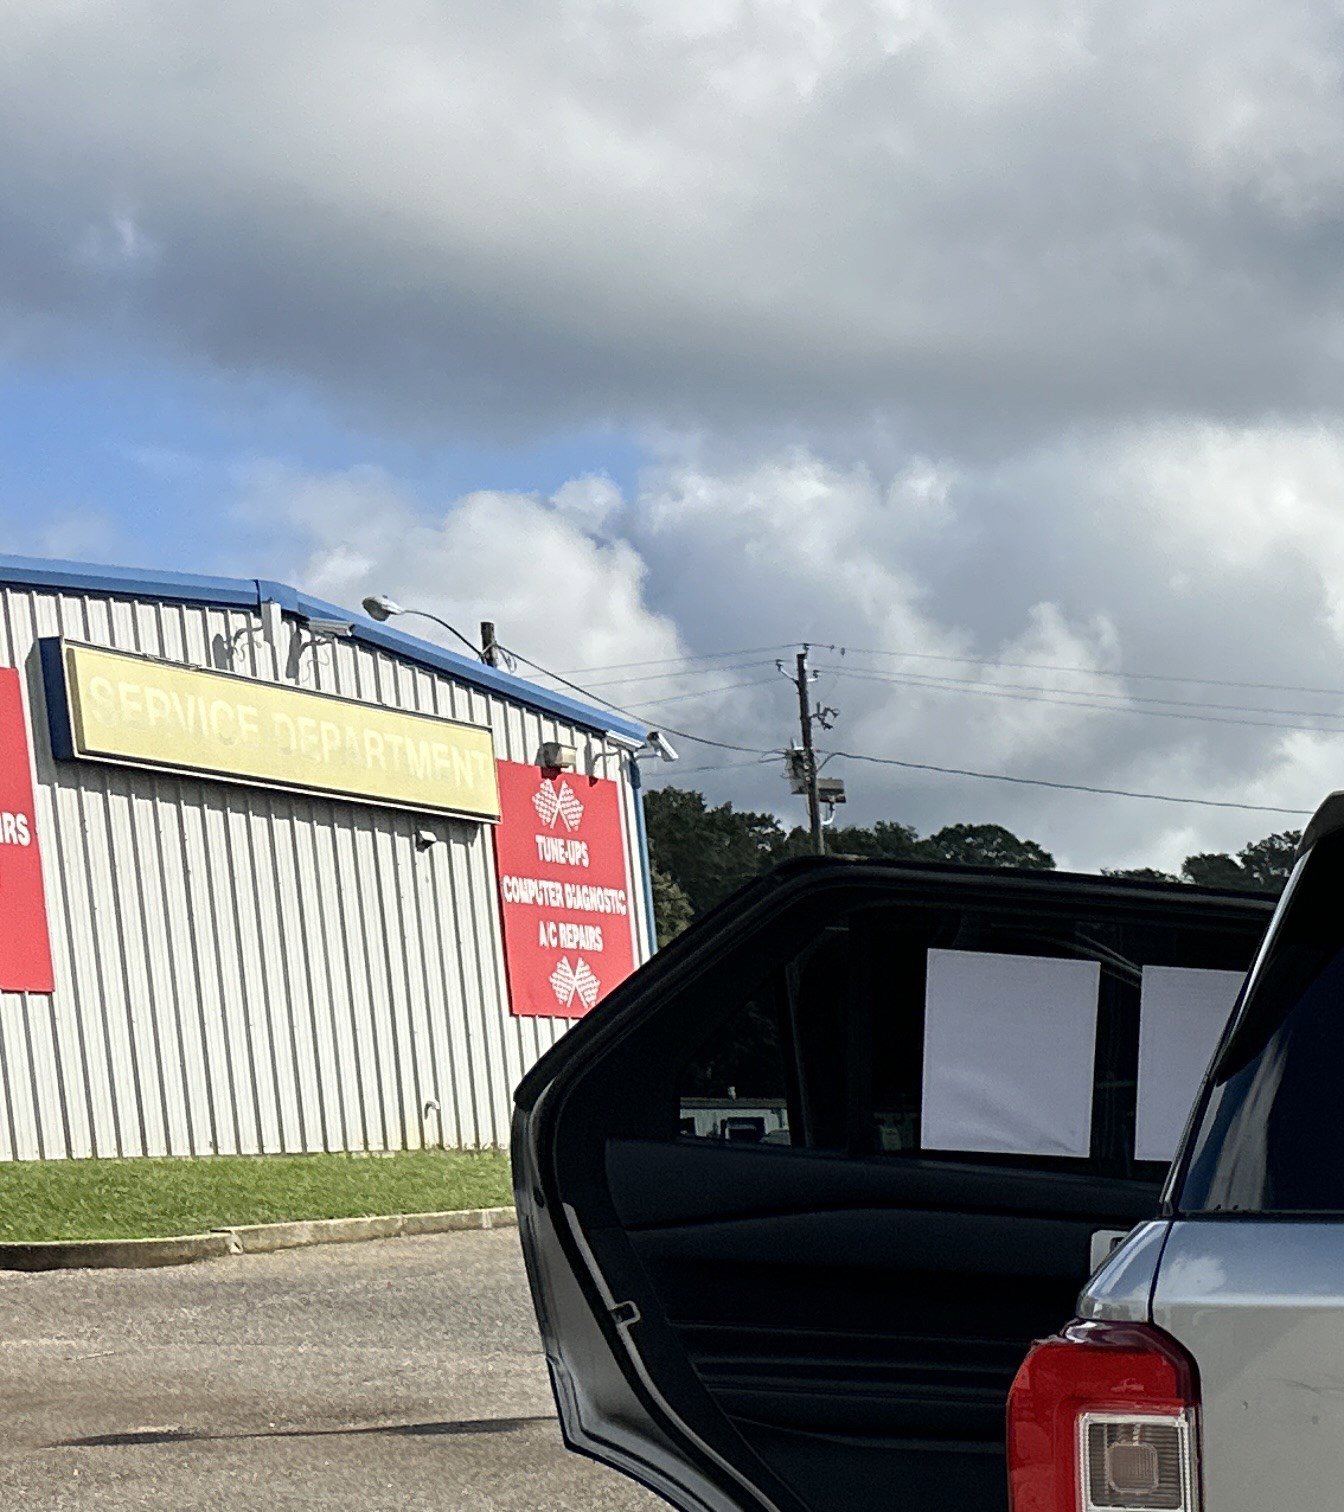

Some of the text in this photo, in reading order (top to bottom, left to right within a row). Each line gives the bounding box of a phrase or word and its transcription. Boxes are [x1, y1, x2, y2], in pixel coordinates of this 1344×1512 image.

[535, 834, 590, 868] TUNE-UPS
[502, 874, 627, 916] COMPUTER DIAGNOSTIC
[558, 921, 604, 953] REPAIRS
